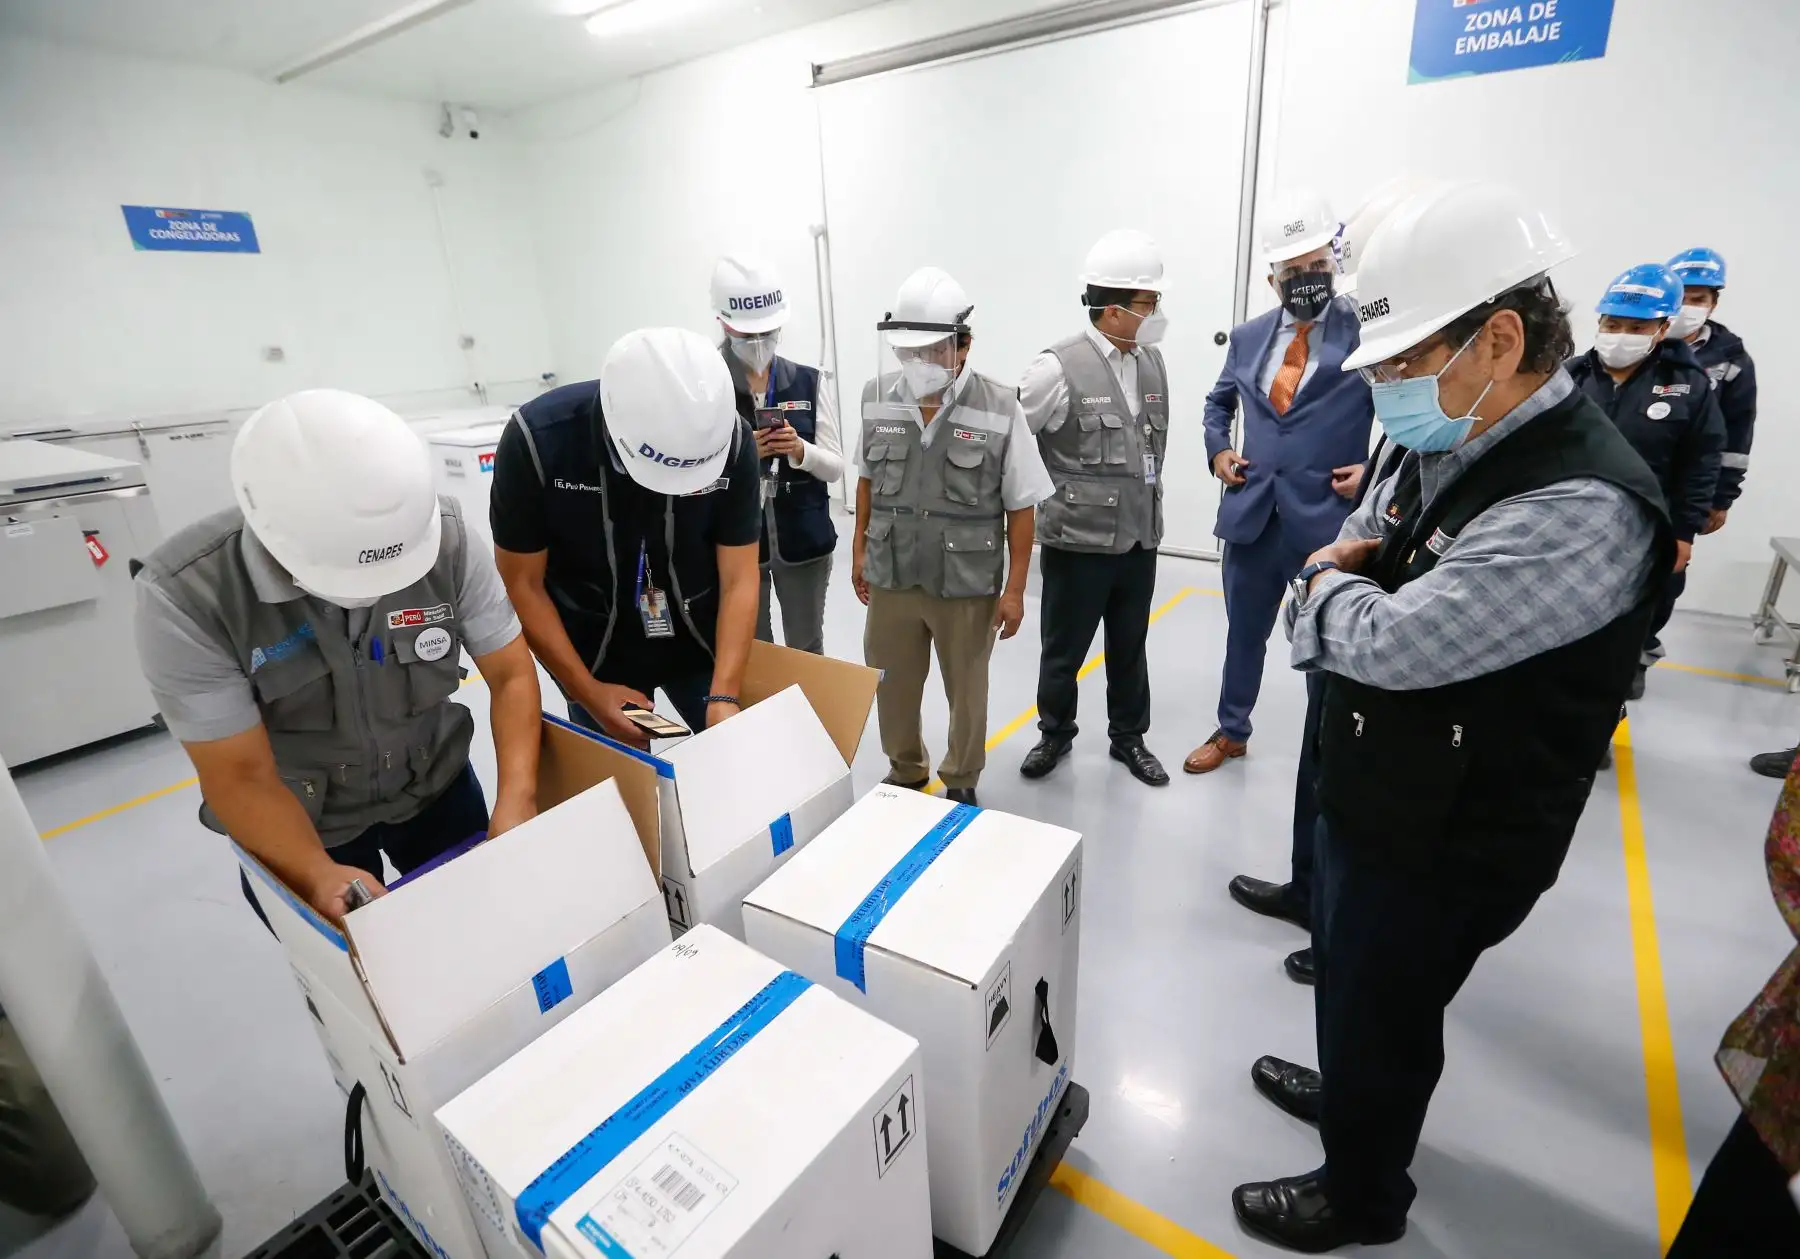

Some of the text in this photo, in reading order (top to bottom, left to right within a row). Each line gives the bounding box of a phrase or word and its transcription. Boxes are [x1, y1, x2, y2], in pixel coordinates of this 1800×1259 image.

[1464, 0, 1557, 32] ZONA DE
[1455, 21, 1563, 55] EMBALAJE
[168, 220, 217, 231] ZONA DE
[1284, 220, 1305, 237] CENARES
[149, 228, 241, 242] CONGELADORAS
[729, 289, 783, 310] DIGEMID
[1291, 291, 1328, 306] WILL WIN
[1081, 396, 1112, 404] CENARES
[875, 425, 906, 434] CENARES
[359, 543, 404, 564] CENARES
[404, 611, 422, 622] PERÚ
[419, 636, 448, 649] MINSA
[850, 891, 880, 924] SECURITY
[988, 974, 1008, 1007] HEAVY
[677, 1030, 750, 1095] SECURITY TAPE
